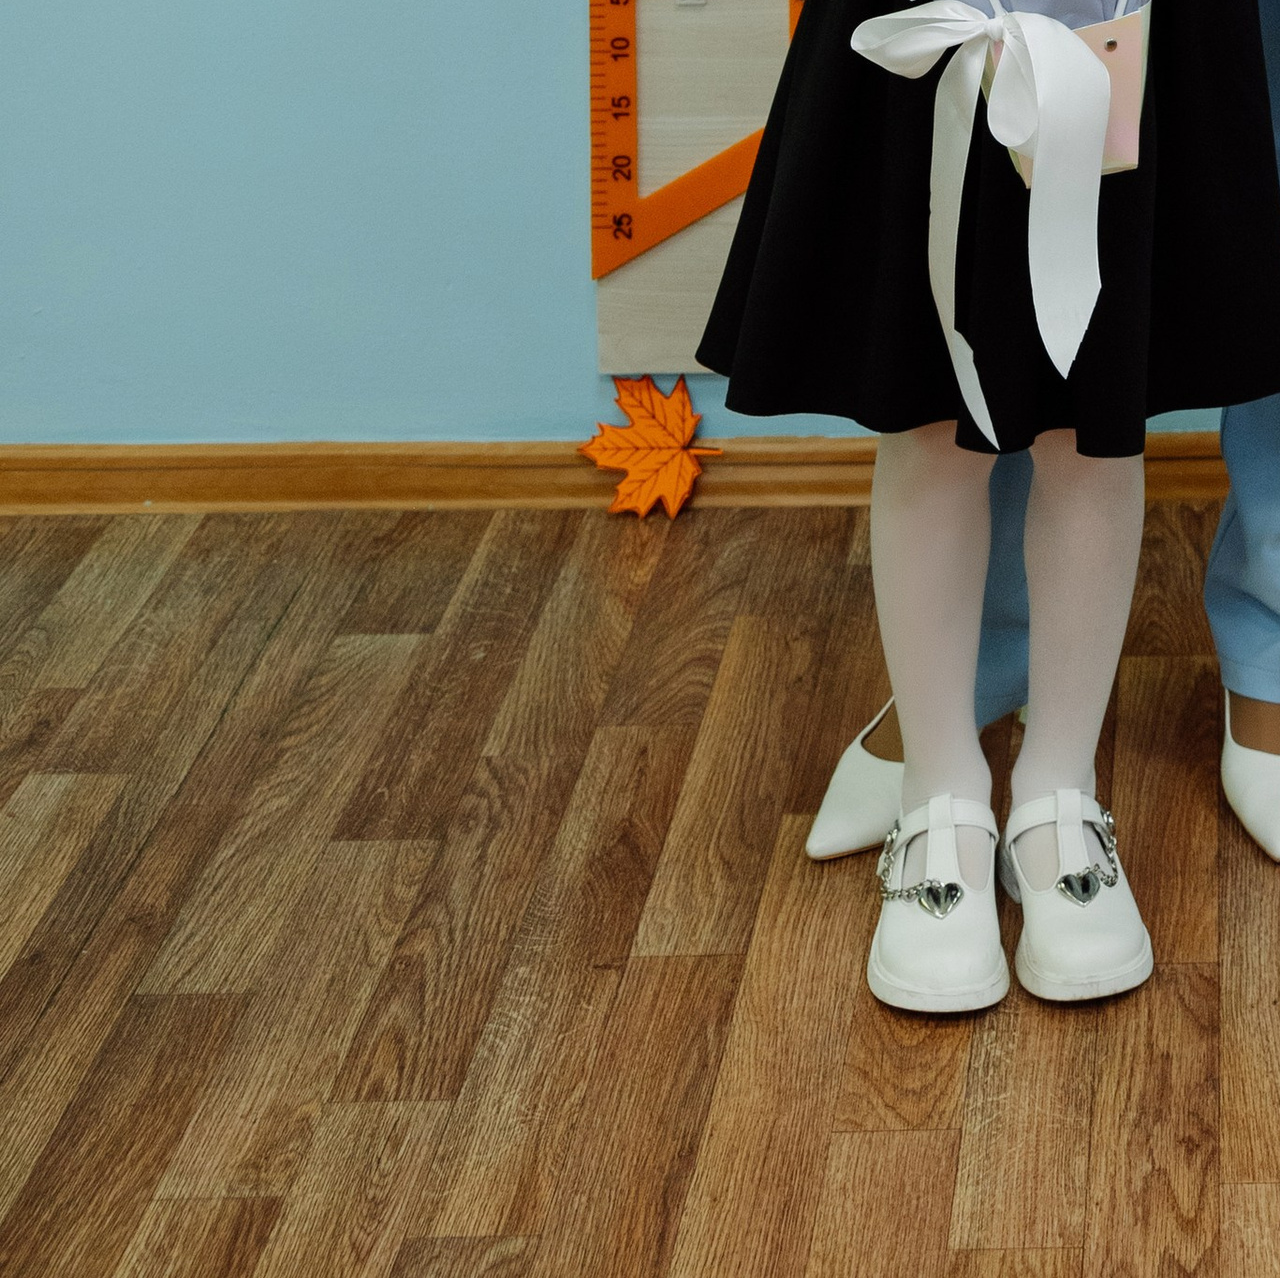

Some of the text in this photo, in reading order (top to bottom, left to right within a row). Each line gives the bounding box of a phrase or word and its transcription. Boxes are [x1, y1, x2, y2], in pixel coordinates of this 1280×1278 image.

[611, 36, 630, 62] 10
[611, 95, 631, 121] 15
[612, 154, 632, 181] 20
[613, 212, 633, 240] 25
